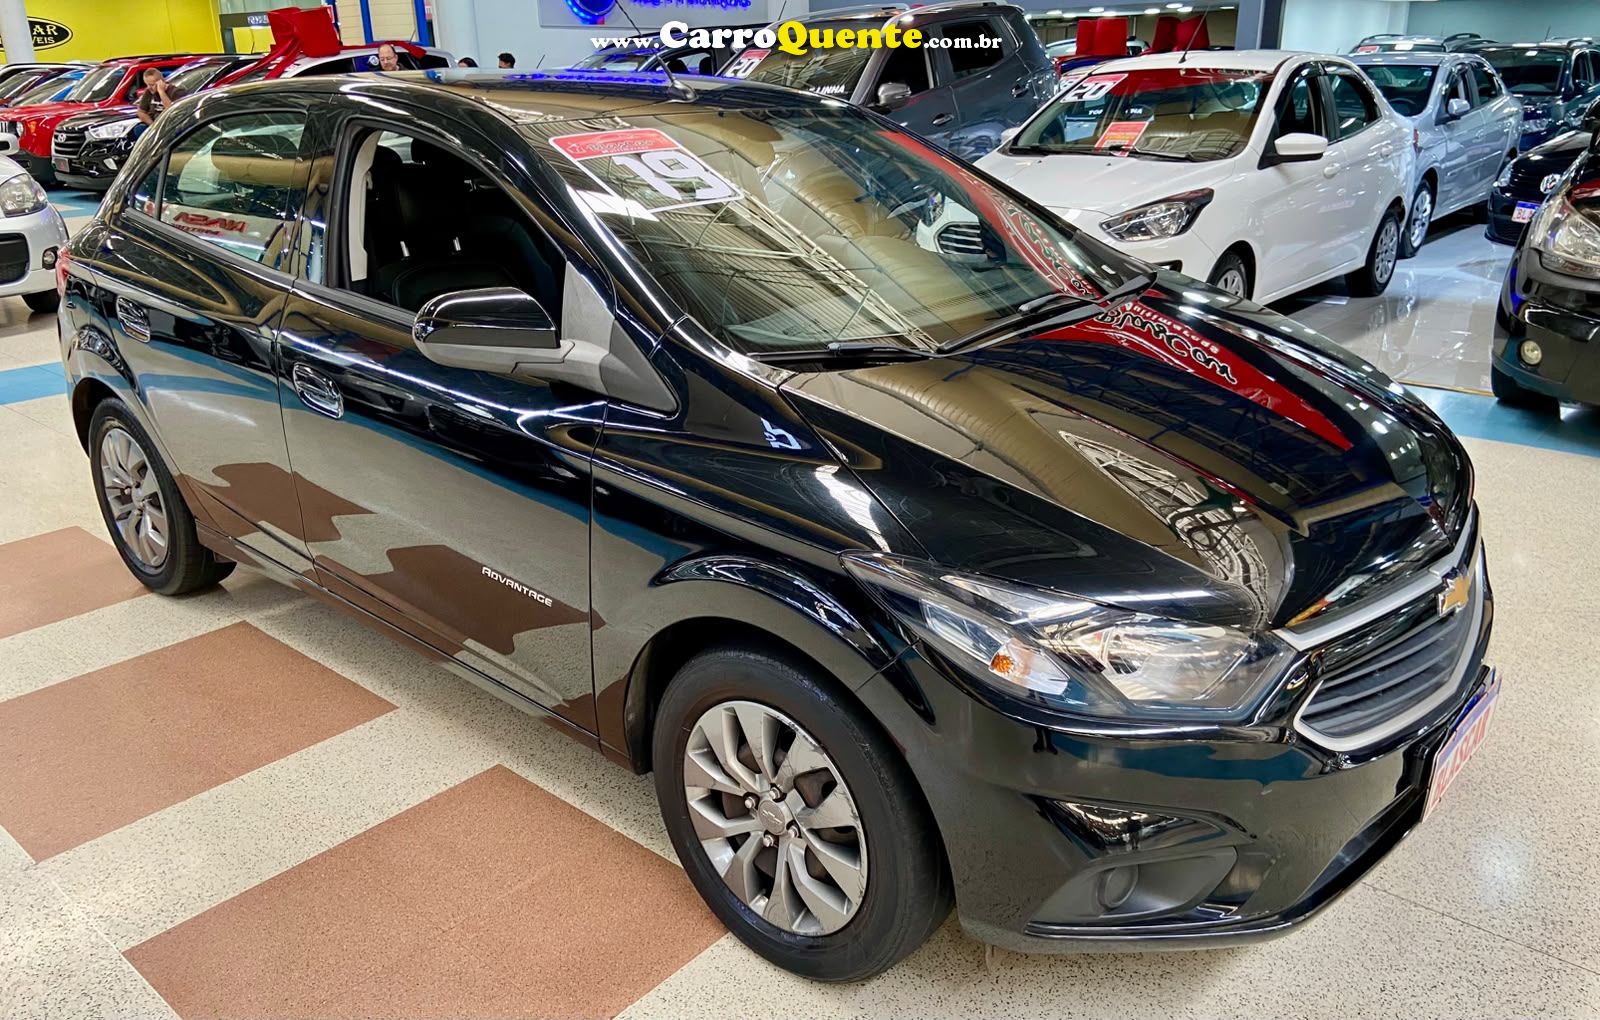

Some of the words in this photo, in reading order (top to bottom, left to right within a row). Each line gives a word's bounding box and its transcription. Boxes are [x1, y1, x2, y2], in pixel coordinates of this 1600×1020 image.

[1065, 81, 1116, 101] 20
[611, 150, 733, 201] 19
[481, 566, 553, 608] ADVANTAGE
